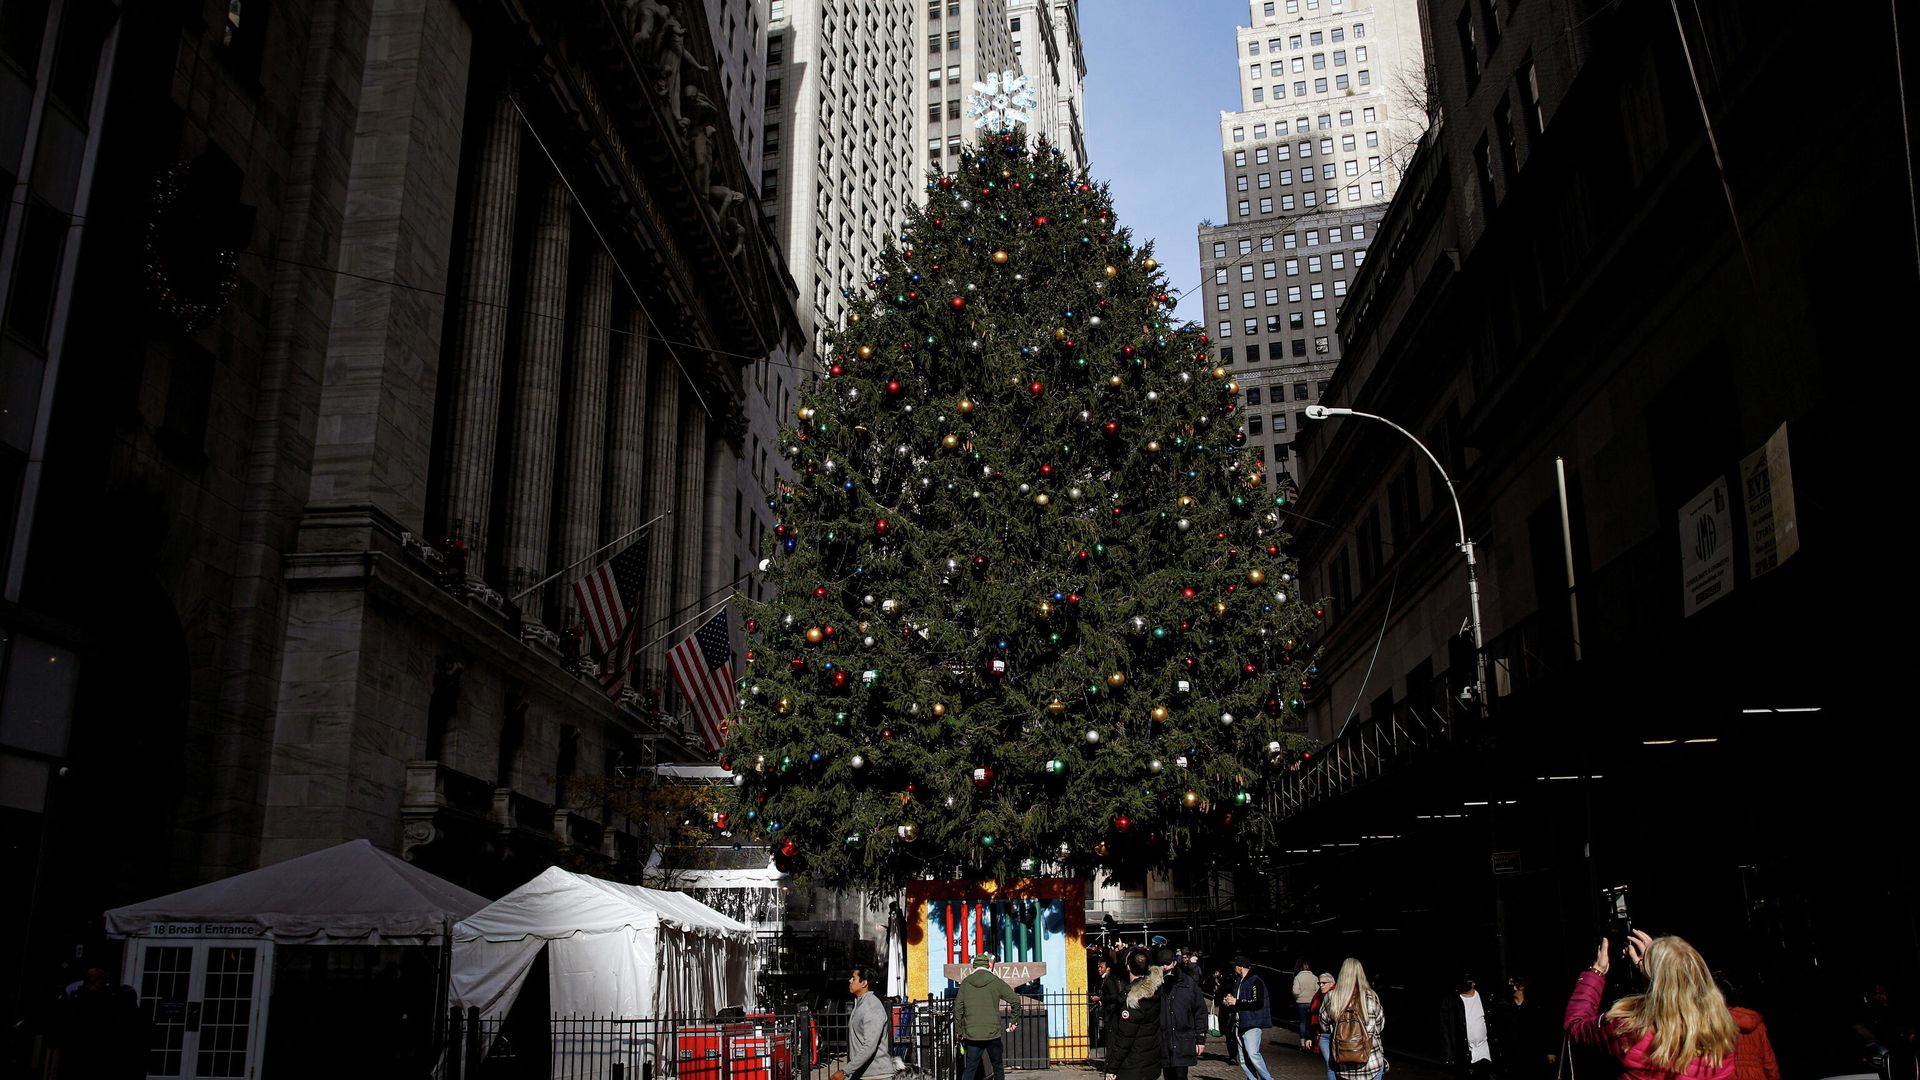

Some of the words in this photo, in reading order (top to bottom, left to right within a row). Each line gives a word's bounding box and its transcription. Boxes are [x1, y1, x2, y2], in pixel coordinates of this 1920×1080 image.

[1696, 514, 1716, 561] JMA
[153, 925, 165, 934] 18
[168, 924, 202, 934] Broad
[205, 924, 254, 934] Entrance
[960, 966, 1030, 979] KNZAA
